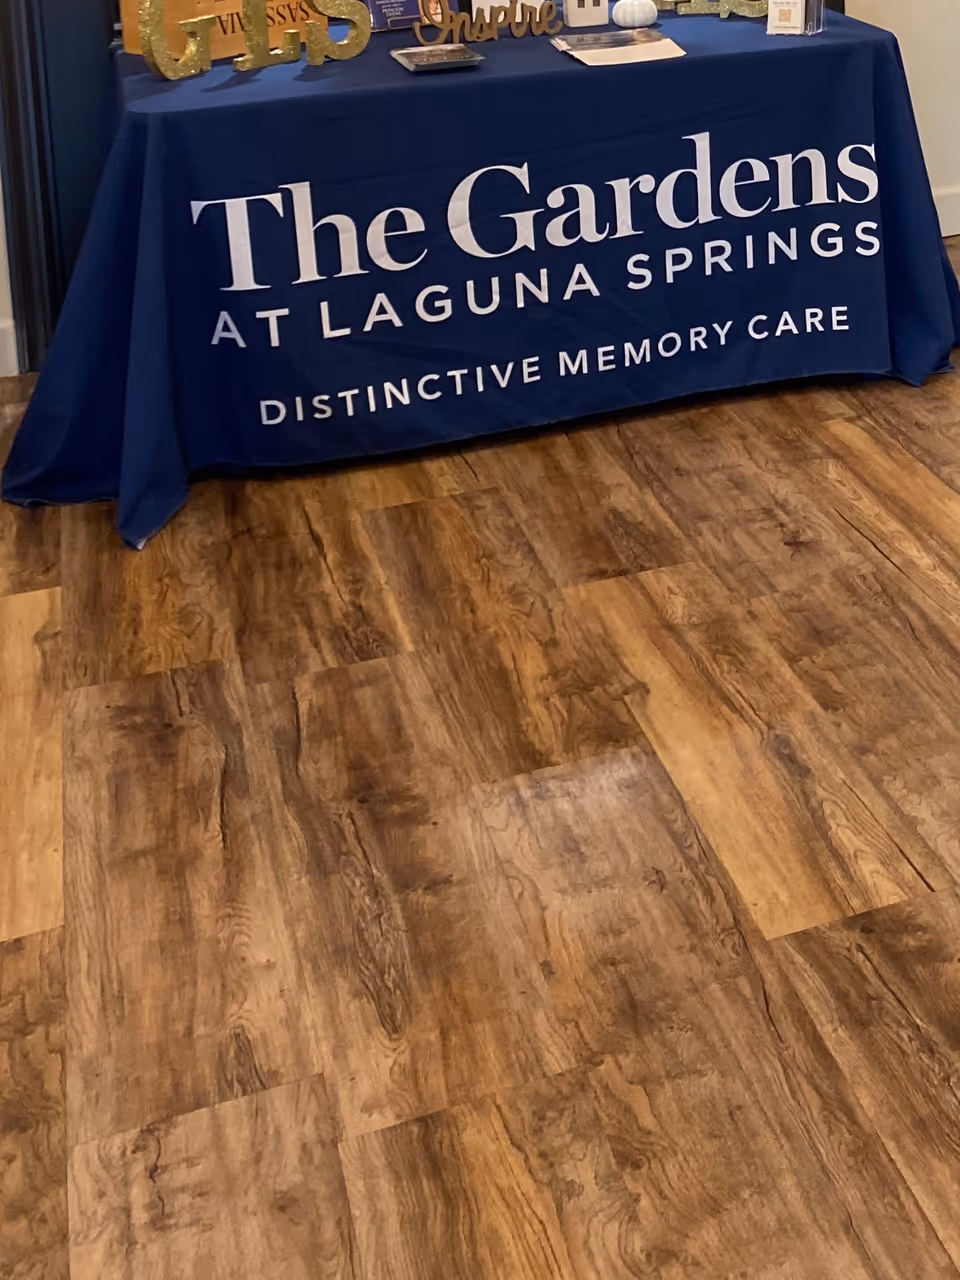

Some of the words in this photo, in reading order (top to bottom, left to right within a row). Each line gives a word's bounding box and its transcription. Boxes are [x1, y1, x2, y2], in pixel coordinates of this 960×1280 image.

[216, 0, 311, 36] SASSAIA
[190, 181, 428, 292] The
[447, 131, 879, 259] Gardens
[211, 308, 290, 349] AT
[319, 263, 601, 340] LAGUNA
[626, 221, 881, 291] SPRINGS
[259, 356, 541, 426] DISTINCTIVE
[558, 321, 734, 377] MEMORY
[747, 305, 850, 340] CARE
